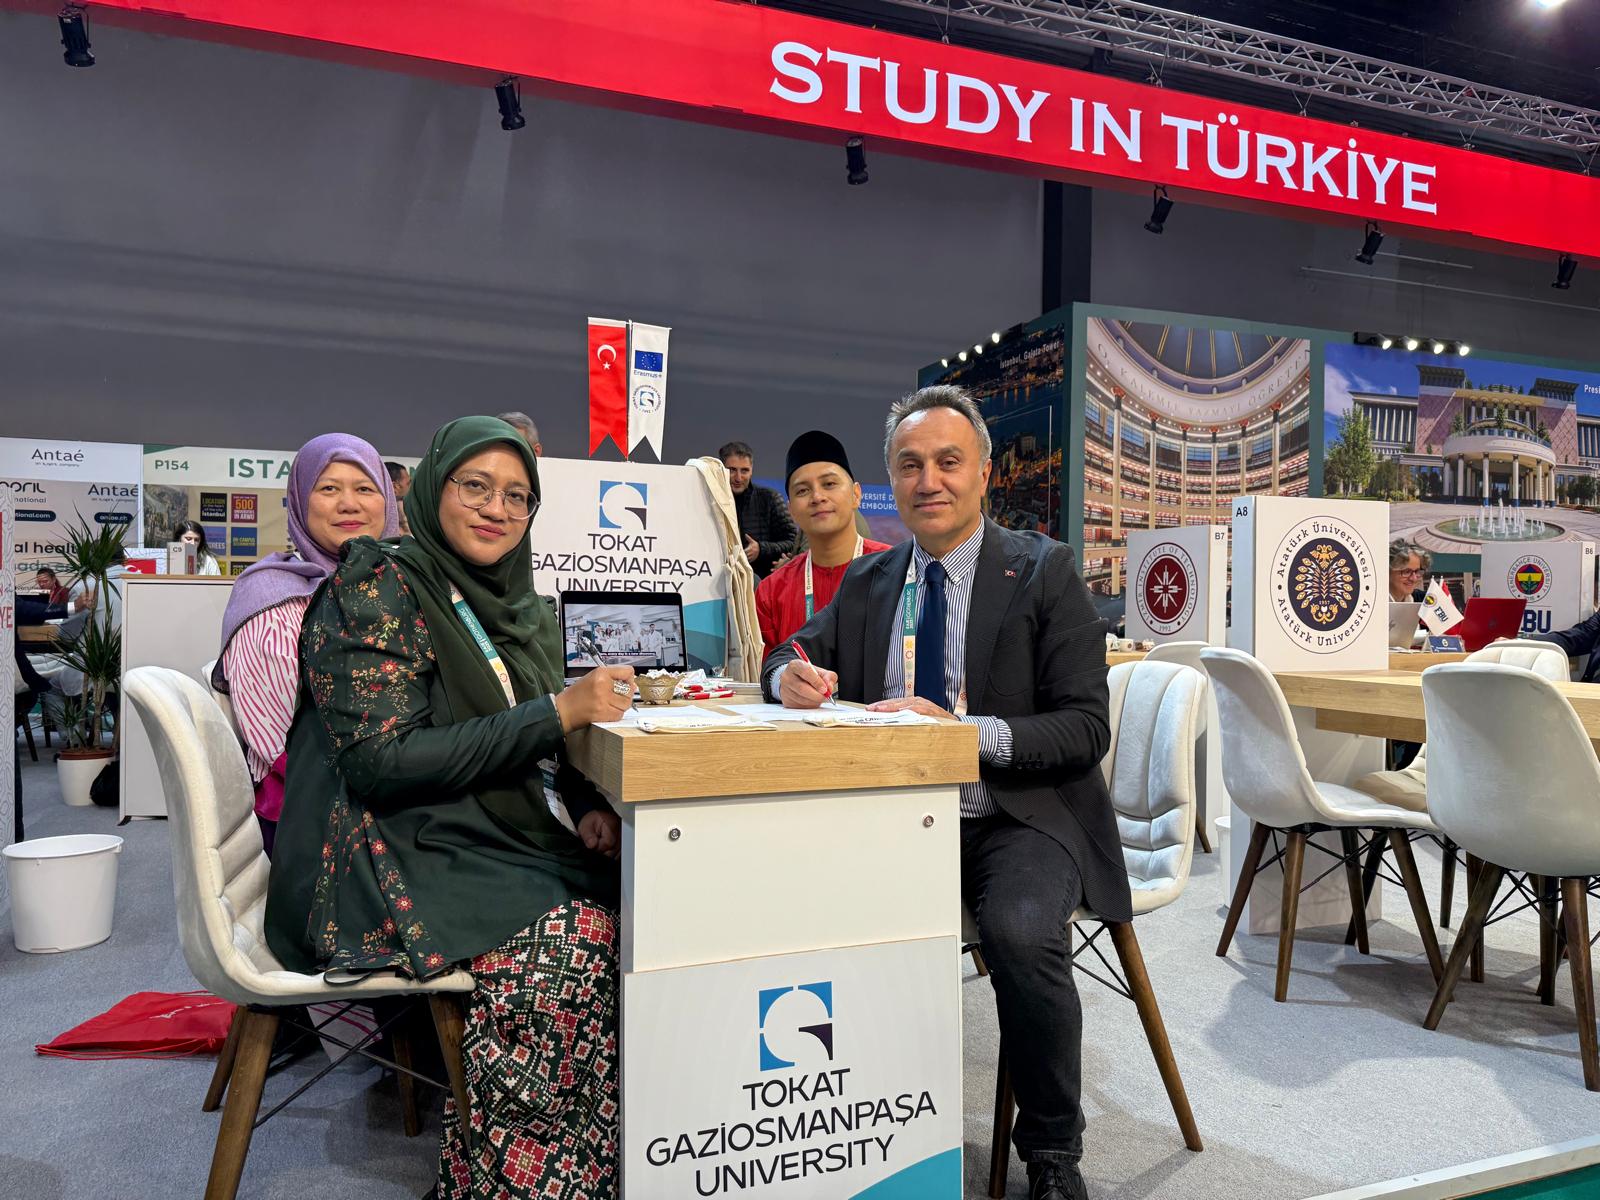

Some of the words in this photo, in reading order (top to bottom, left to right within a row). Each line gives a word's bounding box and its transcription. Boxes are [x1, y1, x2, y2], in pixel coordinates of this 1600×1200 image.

[770, 41, 1051, 143] STUDY
[1069, 96, 1142, 162] IN
[1161, 112, 1438, 215] TÜRKİYE
[633, 370, 663, 378] Erasmus+
[31, 448, 84, 462] Antaé
[155, 460, 189, 471] P154
[229, 458, 291, 479] ISTA
[88, 484, 139, 497] Antaé
[235, 499, 254, 510] 500
[1236, 506, 1248, 517] A8
[15, 542, 28, 553] al
[33, 542, 77, 554] healt
[587, 533, 657, 552] TOKAT
[1277, 529, 1309, 578] Atatürk
[1313, 522, 1371, 578] Üniversitesi
[531, 552, 713, 578] GAZİOSMANPAŞA
[555, 577, 684, 592] UNIVERSITY
[1138, 546, 1167, 587] INSTITUTE
[1169, 546, 1179, 554] OF
[1180, 554, 1196, 623] TECHNOLOGY
[1277, 597, 1312, 644] Atatürk
[1317, 599, 1371, 646] University
[1521, 610, 1551, 633] BU
[742, 1068, 850, 1111] TOKAT
[646, 1091, 937, 1167] GAZİOSMANPAŞA
[695, 1134, 894, 1197] UNIVERSITY
